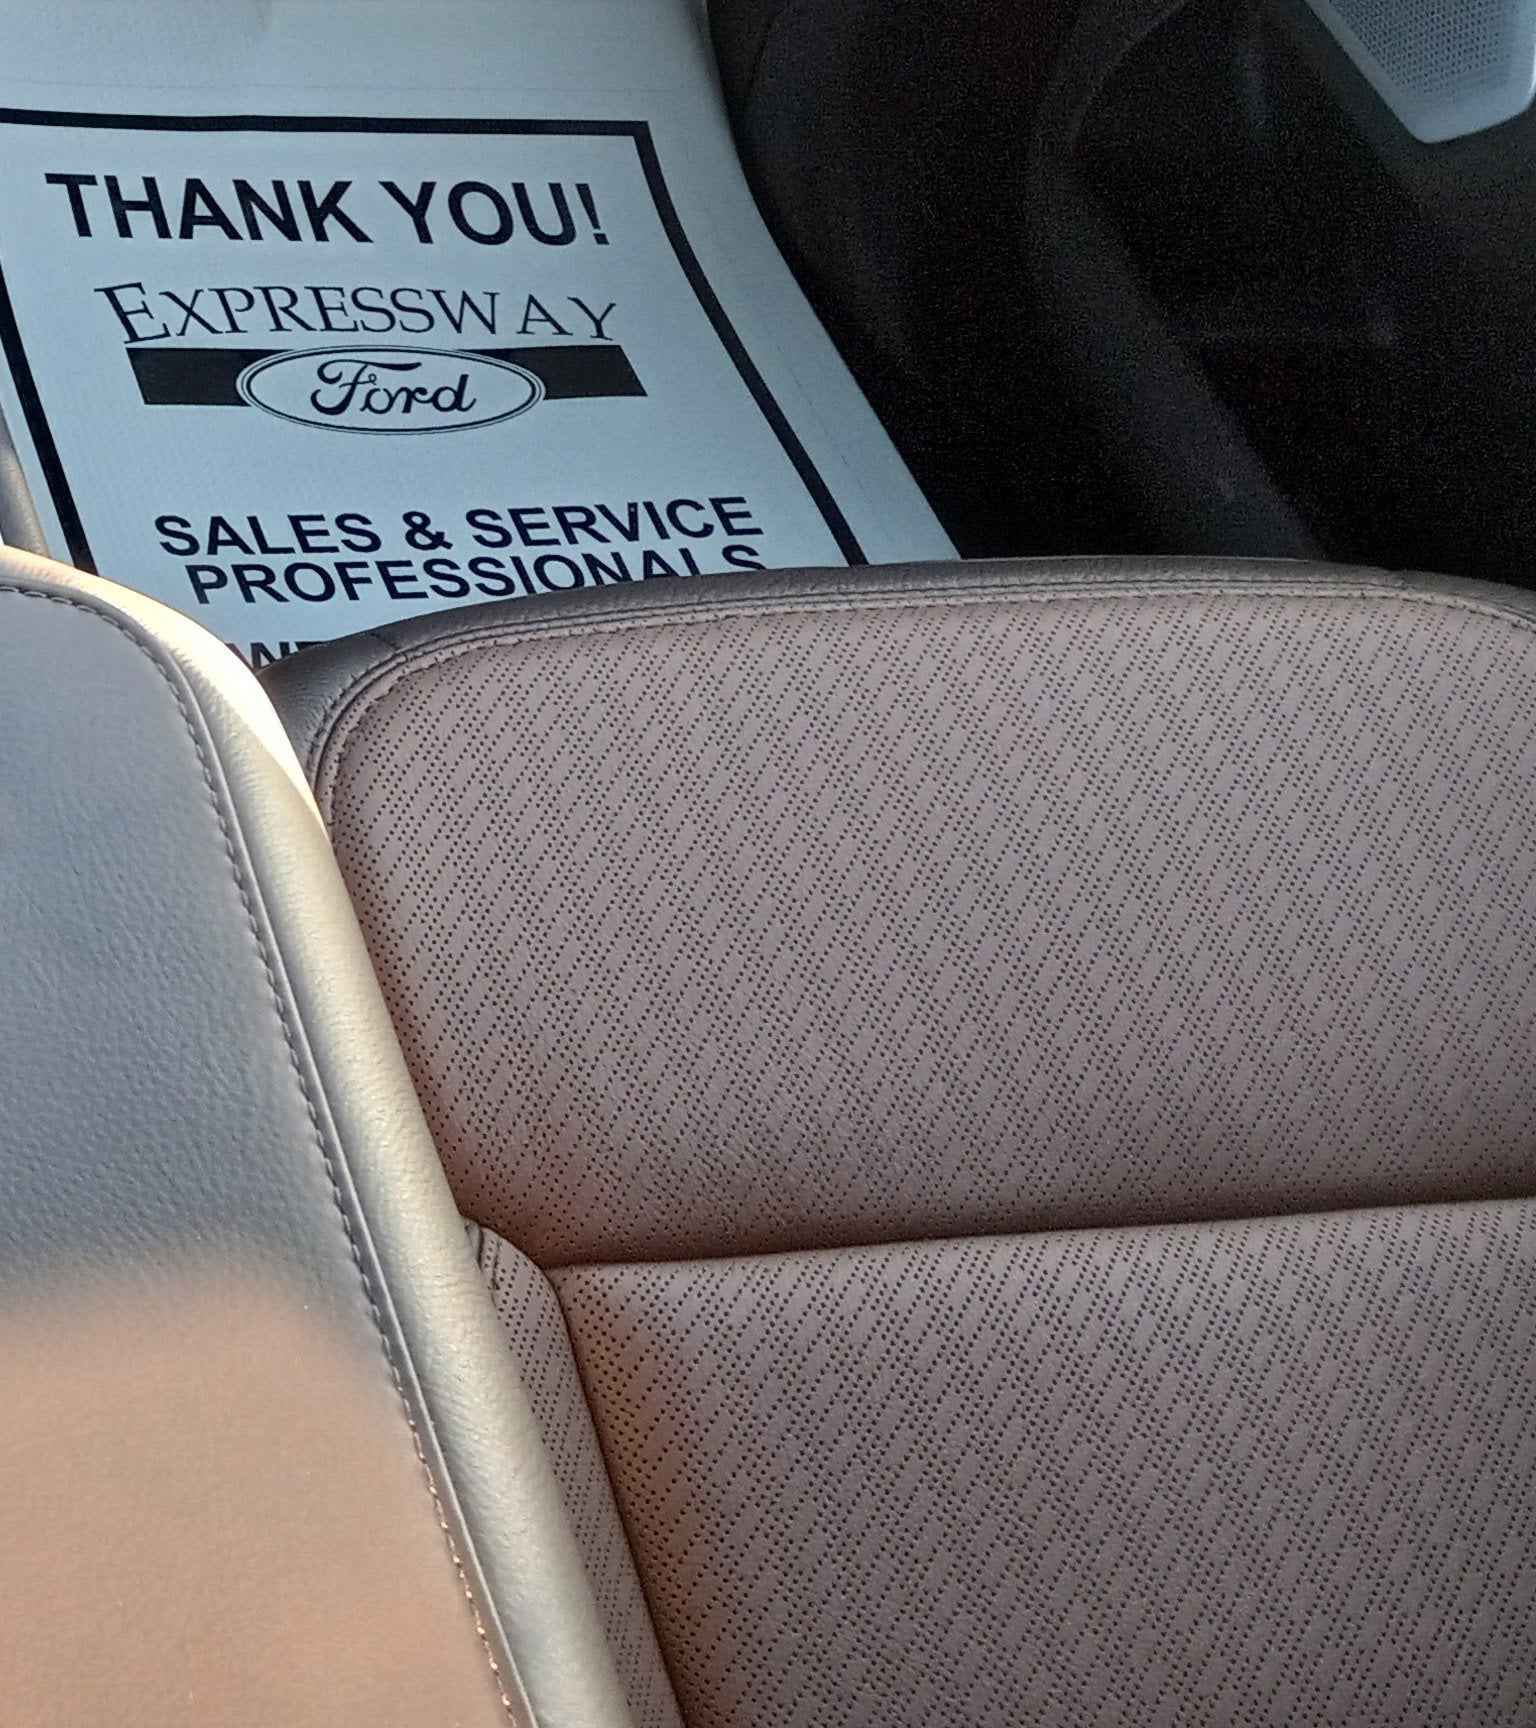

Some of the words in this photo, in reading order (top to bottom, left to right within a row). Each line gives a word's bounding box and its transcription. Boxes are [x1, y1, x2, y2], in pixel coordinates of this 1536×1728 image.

[44, 171, 376, 245] THANK
[379, 179, 611, 247] YOU!
[94, 280, 619, 344] EXPRESSWAY
[309, 359, 478, 417] Ford
[154, 511, 383, 559] SALES
[403, 512, 456, 553] &
[465, 494, 765, 549] SERVICE
